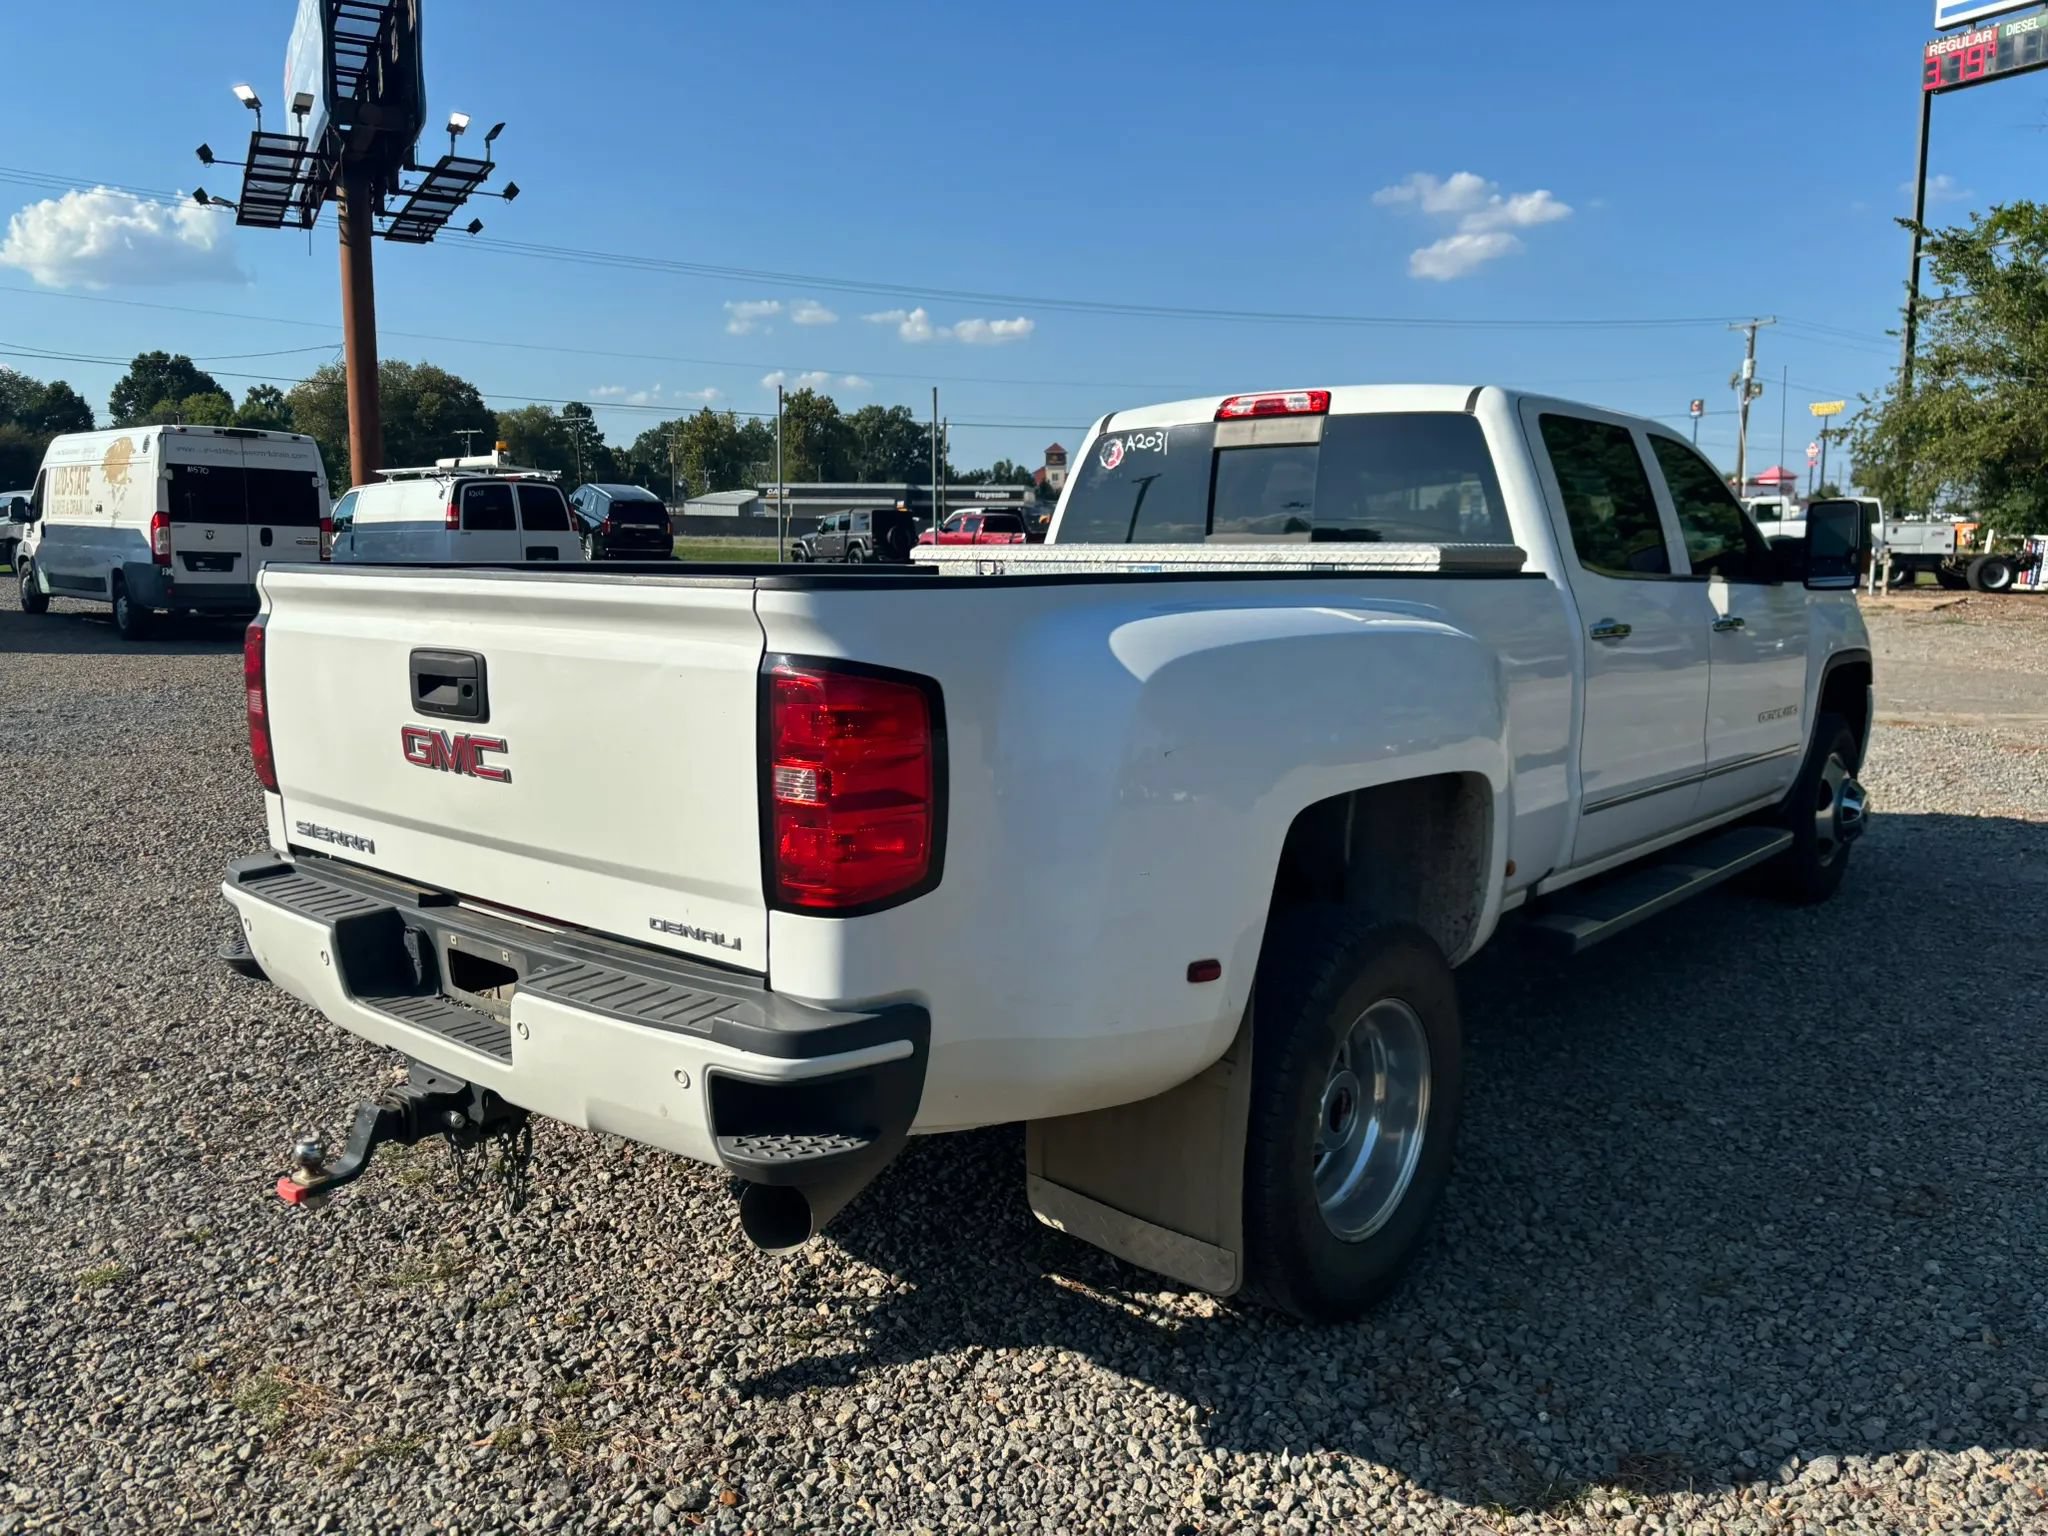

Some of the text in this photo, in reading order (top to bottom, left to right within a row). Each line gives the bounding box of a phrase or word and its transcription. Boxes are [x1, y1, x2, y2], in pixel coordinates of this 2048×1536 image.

[2005, 17, 2039, 36] DIESEL
[1928, 30, 1993, 56] REGULAR
[1125, 431, 1168, 456] A2031
[400, 723, 512, 784] GMC
[296, 820, 376, 855] SIERRA
[649, 917, 742, 952] DENALI
